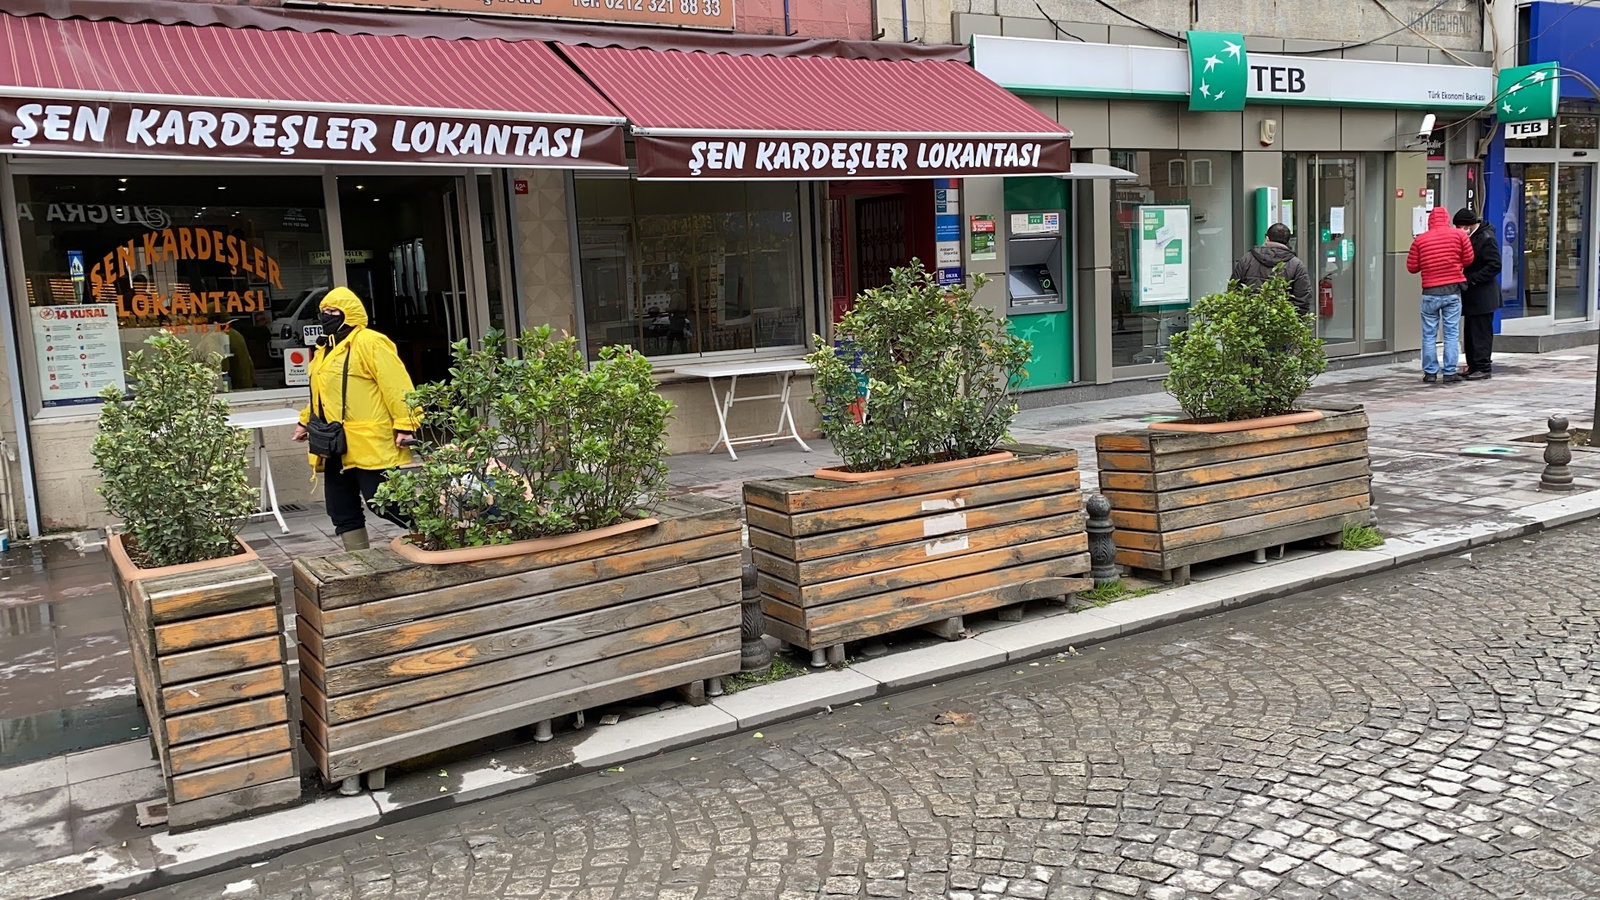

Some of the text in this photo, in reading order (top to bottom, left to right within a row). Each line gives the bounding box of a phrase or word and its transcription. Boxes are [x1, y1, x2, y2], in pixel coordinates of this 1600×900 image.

[648, 0, 674, 13] 321
[680, 0, 698, 15] 88
[702, 0, 721, 17] 33
[1251, 65, 1306, 94] TEB
[1428, 90, 1486, 101] Türk Ekonomi Bankası
[11, 104, 584, 159] ŞEN KARDEŞLER LOKANTASI
[1511, 122, 1541, 135] TEB
[688, 141, 1042, 175] ŞEN KARDEŞLER LOKANTASI
[90, 227, 285, 304] ŞEN KARDEŞLER
[55, 308, 109, 320] 14 KURAL
[117, 290, 266, 317] LOKANTASI
